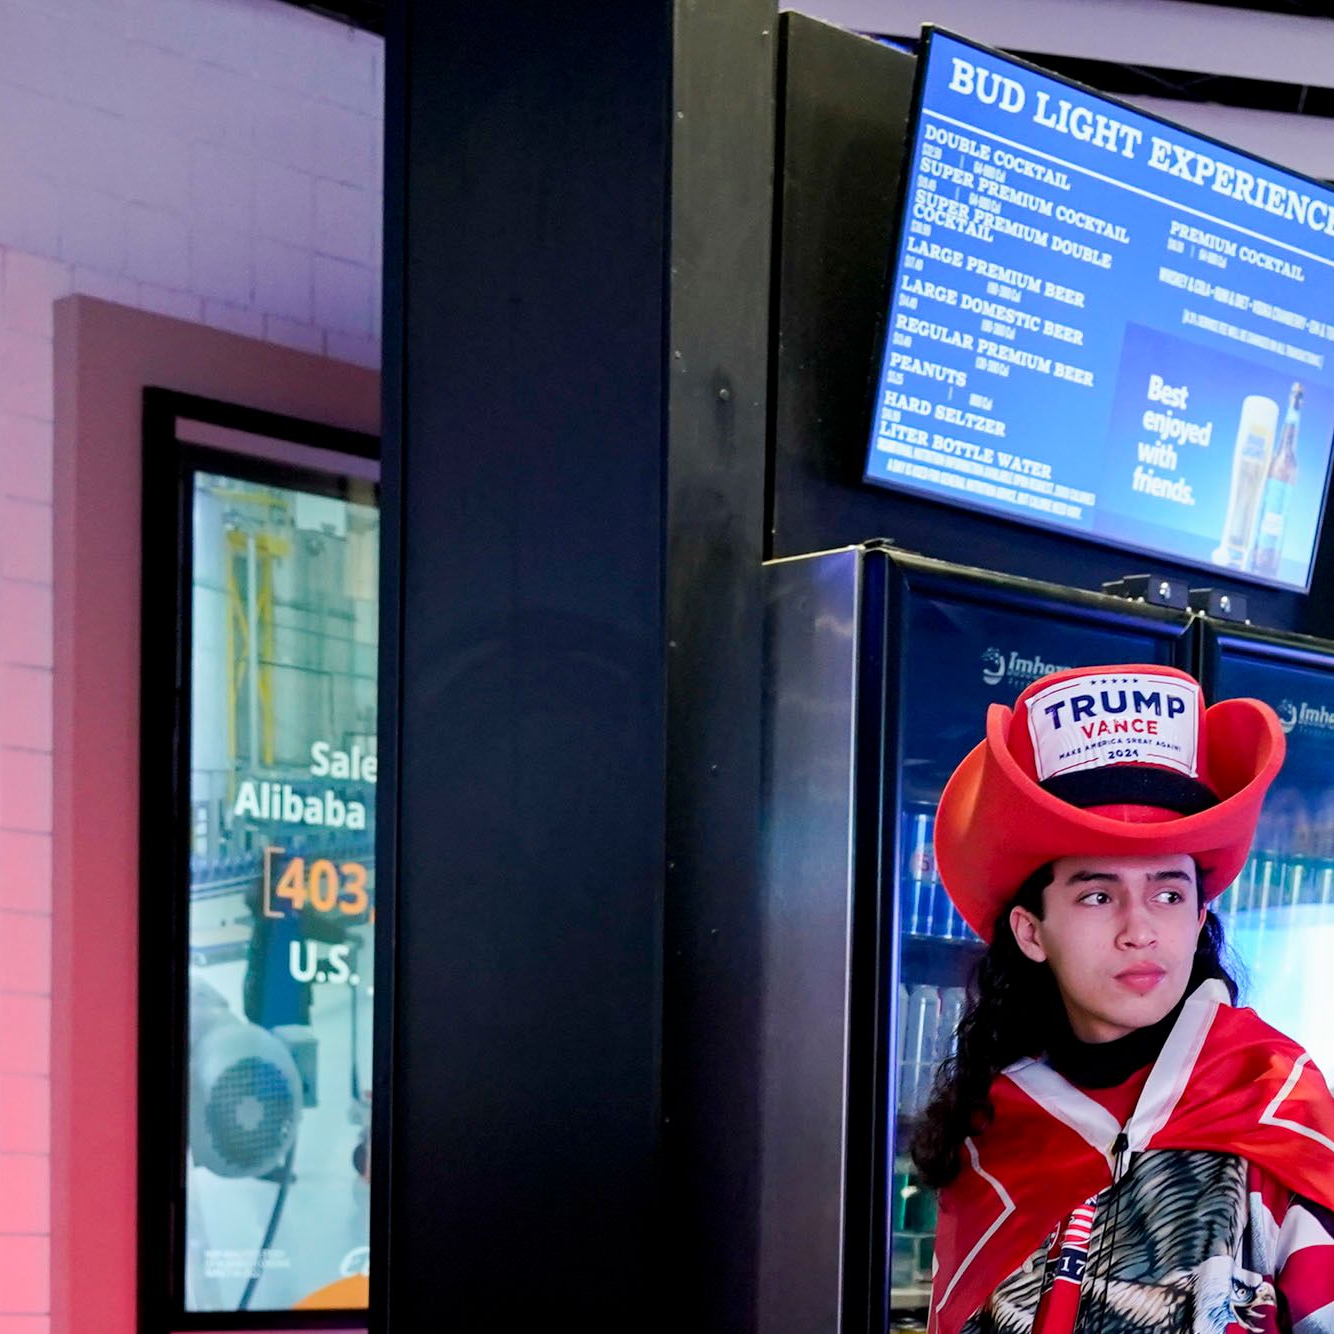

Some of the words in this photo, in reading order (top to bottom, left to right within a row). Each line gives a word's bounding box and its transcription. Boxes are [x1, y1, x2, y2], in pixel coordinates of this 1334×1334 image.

[949, 57, 1026, 113] BUD
[1033, 91, 1143, 159] LIGHT
[924, 123, 992, 162] DOUBLE
[992, 149, 1071, 191] COCKTAIL
[912, 203, 994, 243] COCKTAIL
[919, 155, 975, 189] SUPER
[977, 176, 1054, 217] PREMIUM
[1055, 205, 1130, 244] COCKTAIL
[913, 187, 971, 221] SUPER
[972, 208, 1049, 247] PREMIUM
[1050, 235, 1113, 269] DOUBLE
[1169, 220, 1238, 257] PREMIUM
[1238, 246, 1305, 282] COCKTAIL
[906, 235, 964, 268] LARGE
[966, 255, 1042, 294] PREMIUM
[1043, 281, 1085, 308] BEER
[900, 274, 959, 306] LARGE
[960, 293, 1042, 332] DOMESTIC
[1042, 320, 1084, 346] BEER
[889, 351, 968, 388] PEANUTS
[895, 313, 974, 351] REGULAR
[976, 338, 1052, 374] PREMIUM
[1053, 361, 1094, 387] BEER
[883, 389, 933, 417] HARD
[933, 404, 1006, 437] SELTZER
[1147, 374, 1190, 411] Best
[878, 419, 930, 447] LITER
[931, 433, 995, 465] BOTTLE
[996, 451, 1052, 480] WATER
[1142, 409, 1214, 447] enjoyed
[1137, 440, 1179, 471] with
[1132, 467, 1197, 506] friends.
[1044, 690, 1186, 730] TRUMP
[1081, 718, 1159, 740] VANCE
[1059, 747, 1082, 760] MAKE
[1084, 738, 1122, 752] AMERICA
[1126, 737, 1153, 746] GREAT
[1108, 748, 1139, 760] 2024
[234, 782, 365, 830] Alibaba
[289, 940, 361, 987] U.S.
